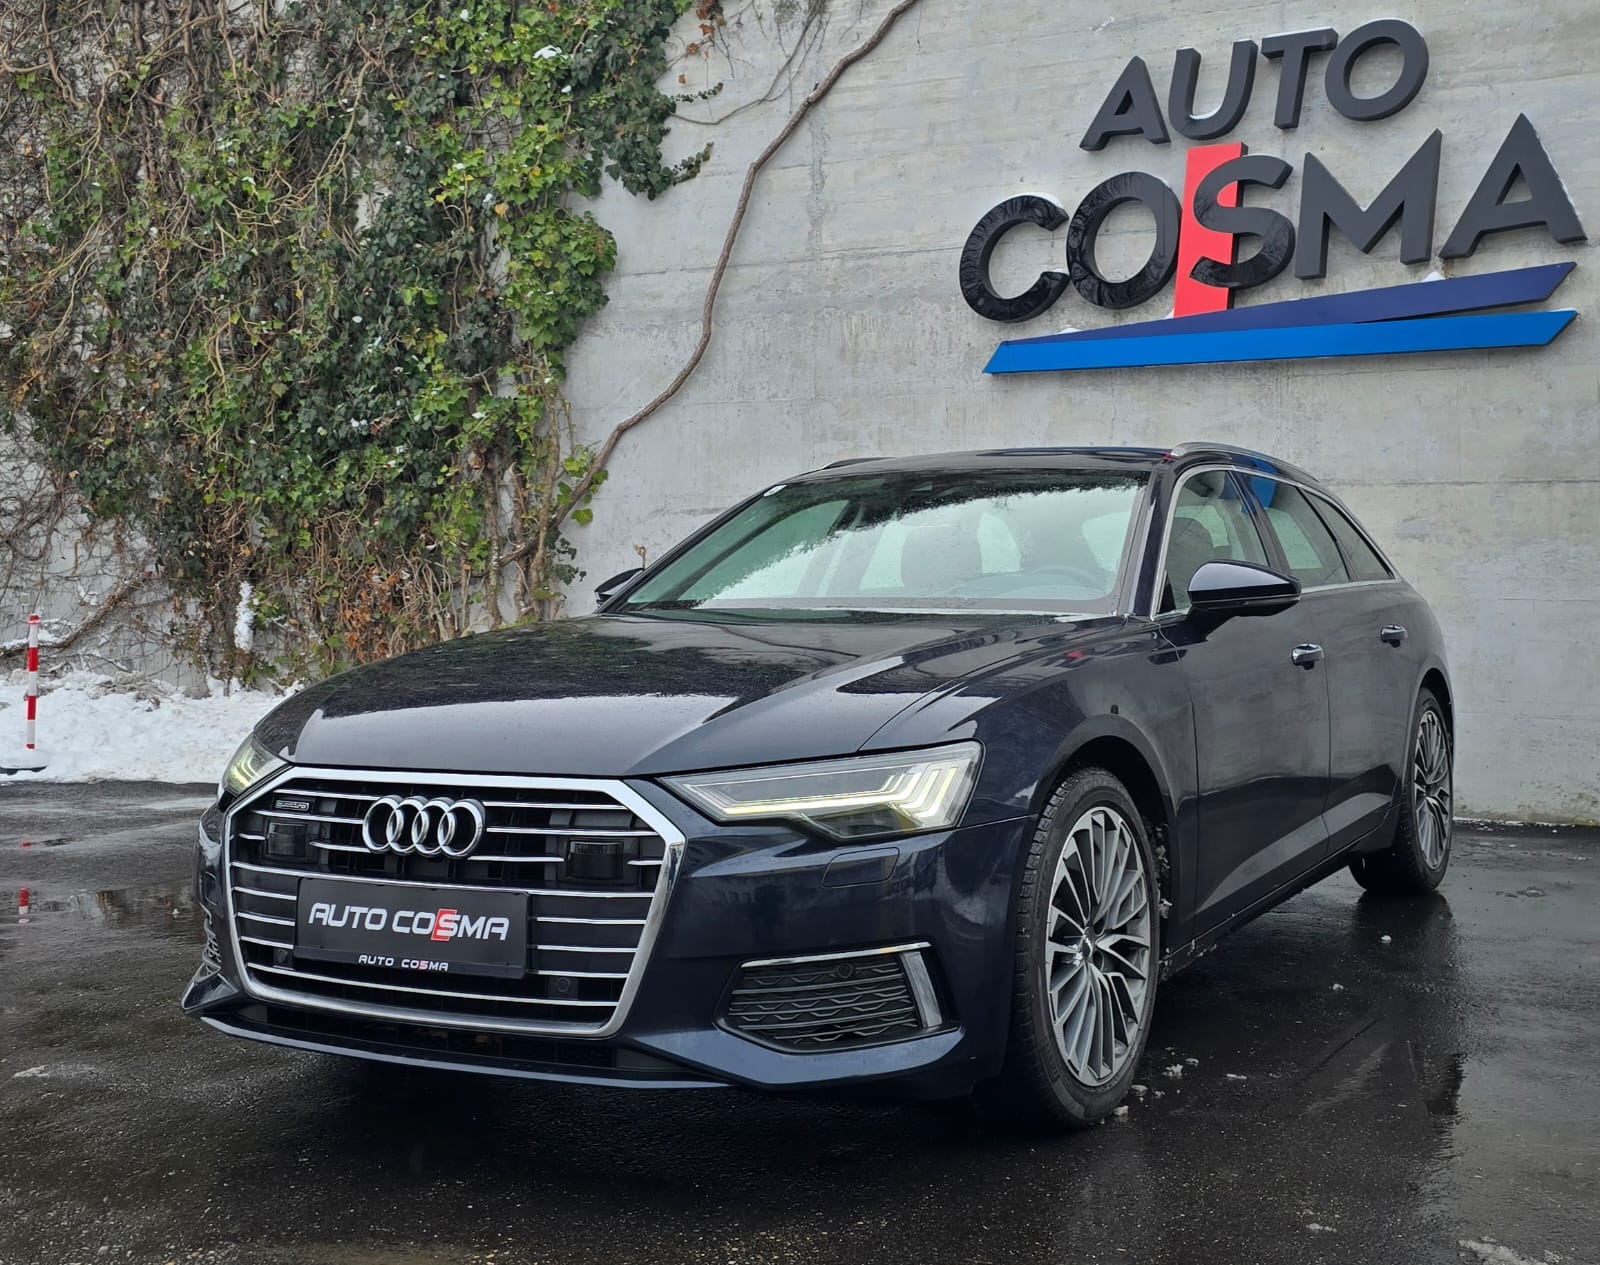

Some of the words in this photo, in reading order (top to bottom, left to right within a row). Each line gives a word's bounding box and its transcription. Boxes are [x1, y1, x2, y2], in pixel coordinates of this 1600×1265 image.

[1079, 18, 1430, 151] AUTO
[958, 113, 1588, 323] COSMA
[308, 902, 388, 931] AUTO
[391, 910, 510, 941] COSMA
[358, 954, 395, 967] AUTO
[401, 958, 449, 972] COSMA
